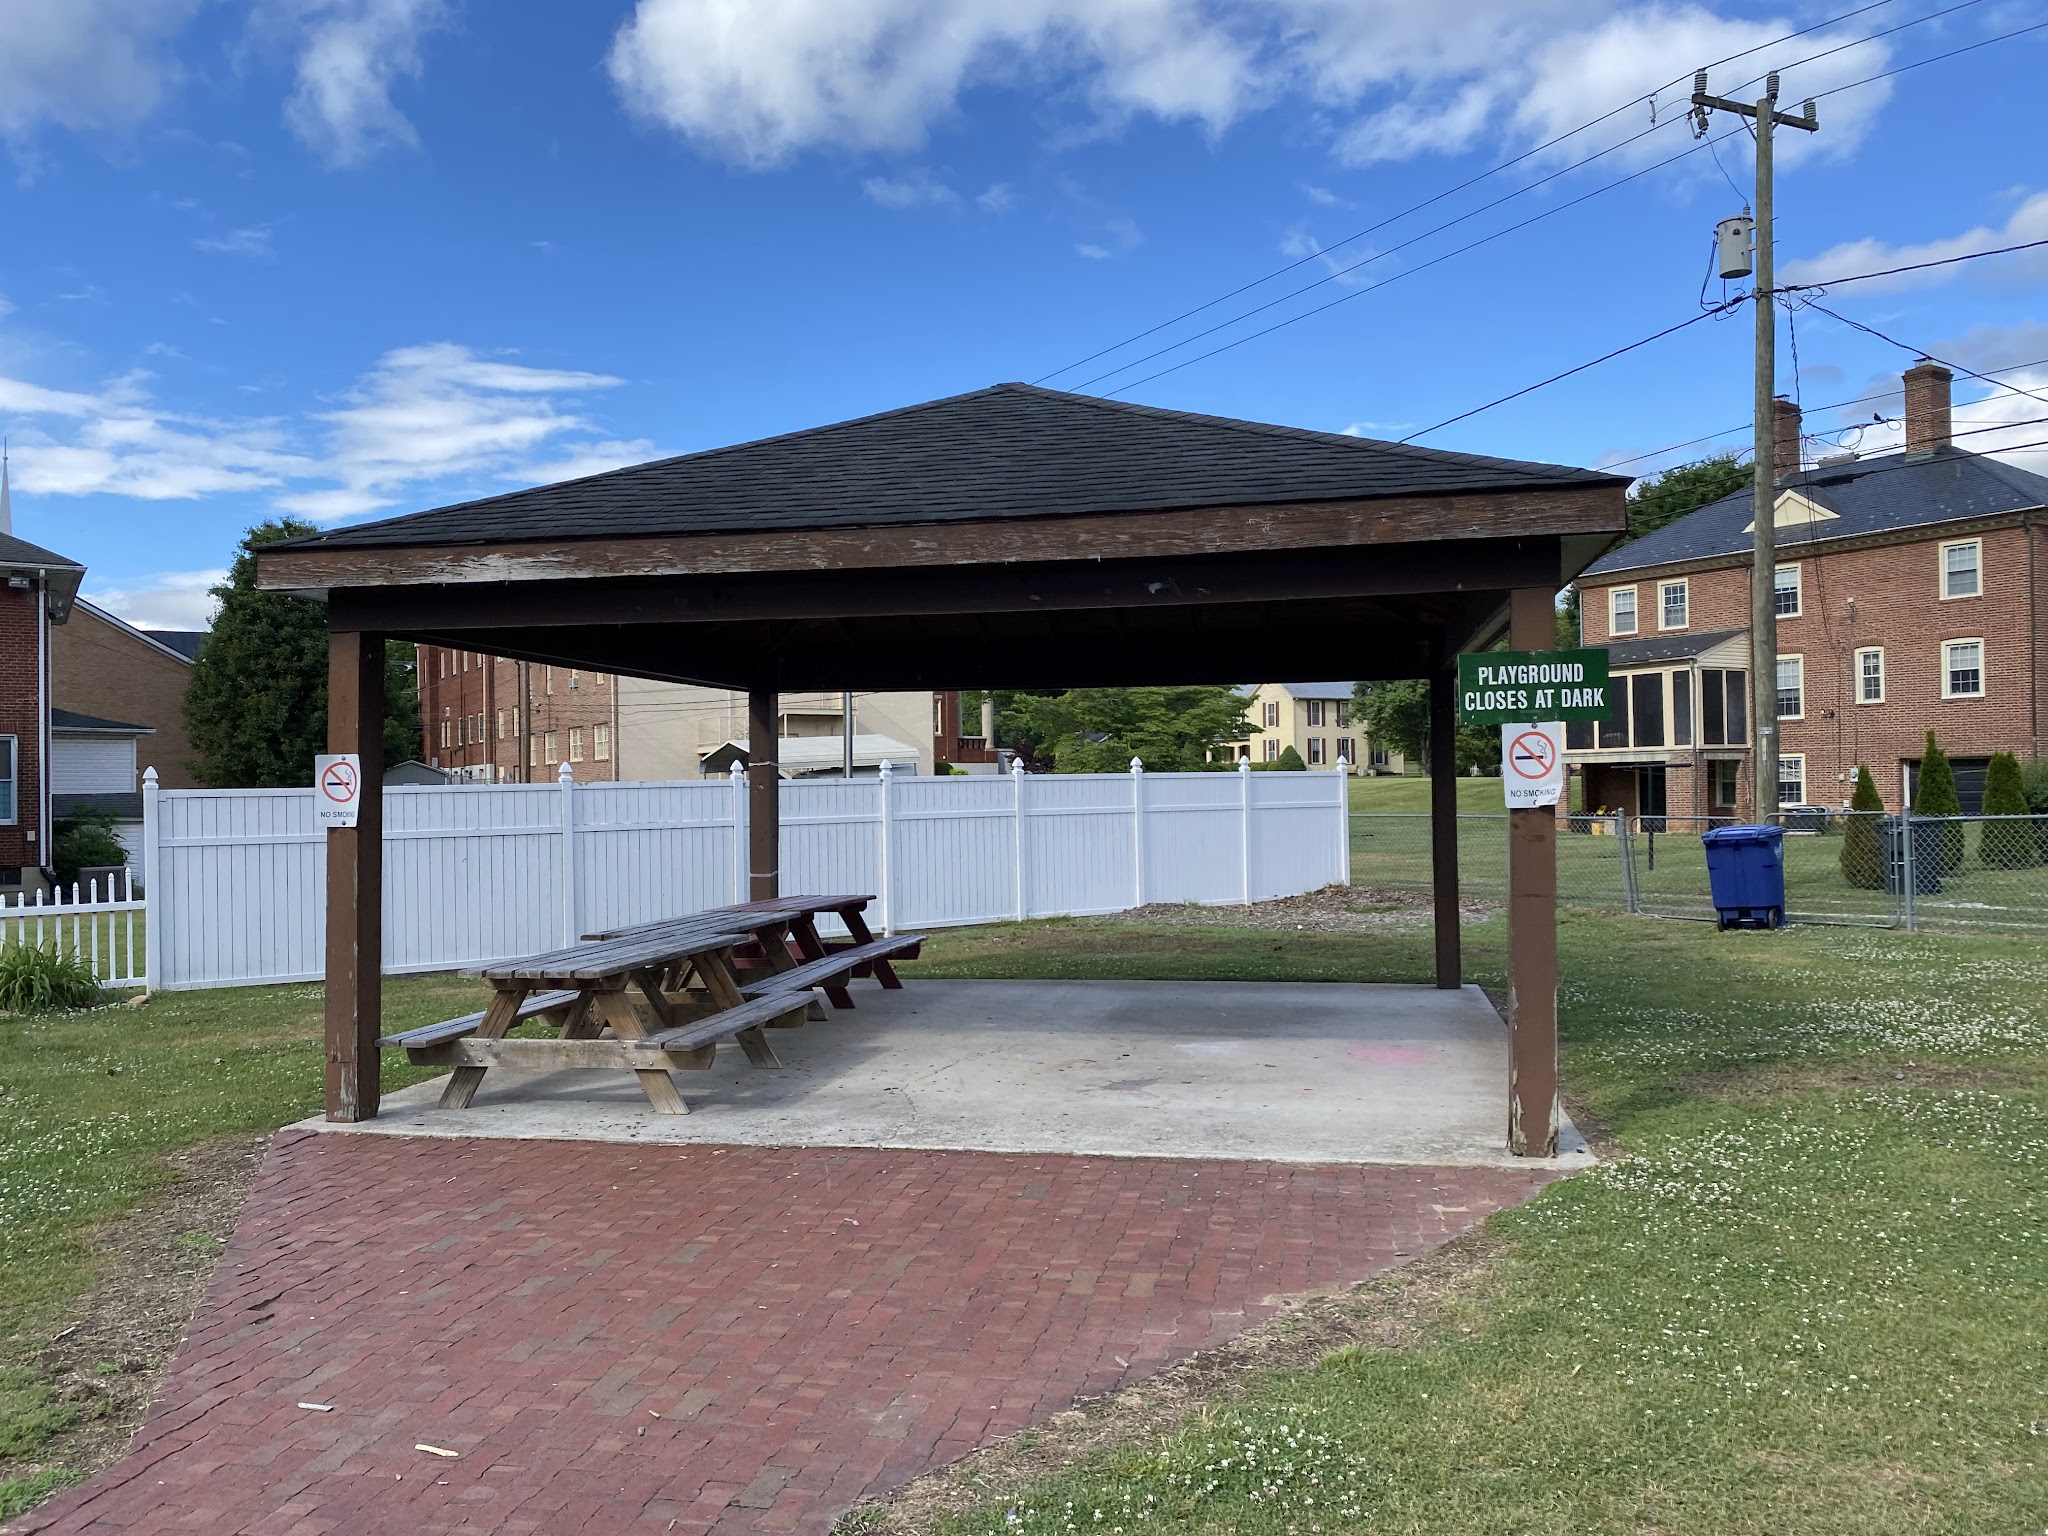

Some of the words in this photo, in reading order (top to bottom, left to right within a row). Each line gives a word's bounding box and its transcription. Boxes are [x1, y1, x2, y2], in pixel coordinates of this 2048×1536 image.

[1478, 663, 1584, 685] PLAYGROUND
[1465, 690, 1528, 711] CLOSES
[1535, 689, 1555, 709] AT
[1561, 687, 1605, 708] DARK
[1523, 788, 1556, 797] SMOKING
